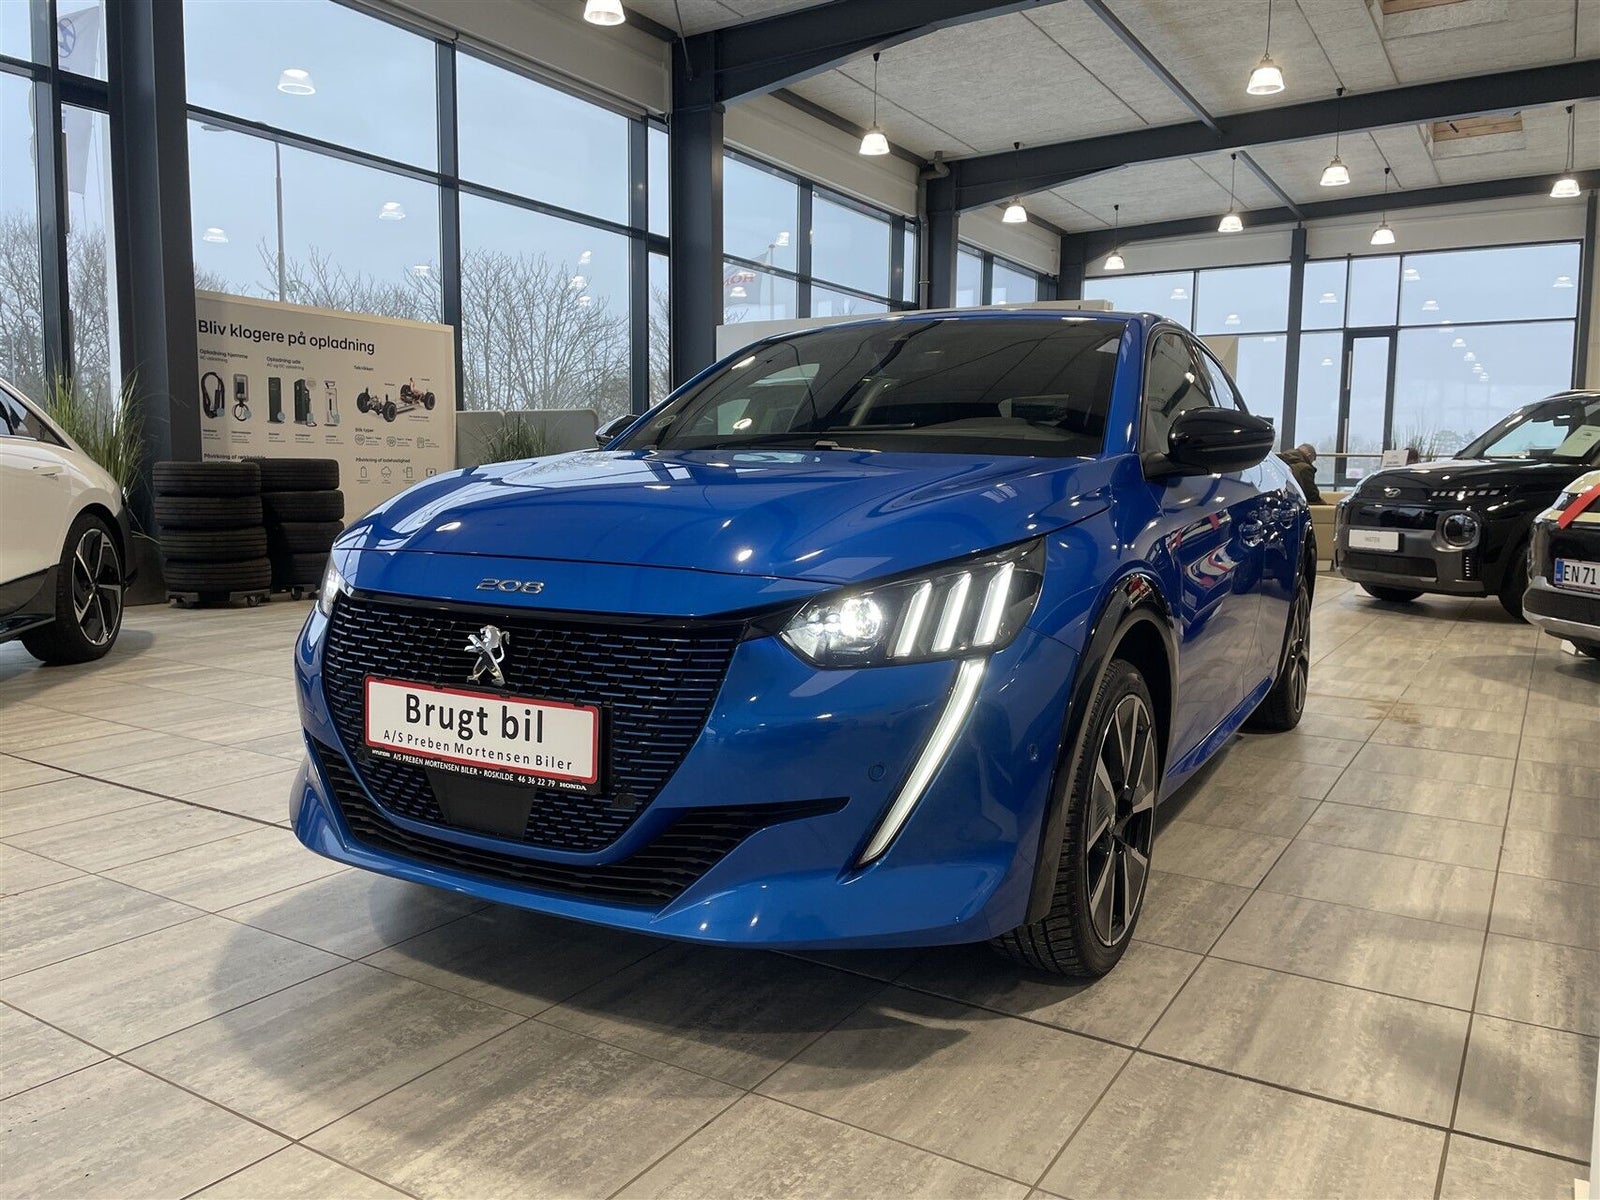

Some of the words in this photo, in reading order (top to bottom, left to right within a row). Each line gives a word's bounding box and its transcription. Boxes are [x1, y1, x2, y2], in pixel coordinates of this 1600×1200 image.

[198, 320, 226, 336] Bliv
[230, 323, 284, 343] klogere
[288, 332, 306, 346] på
[309, 334, 375, 355] opladning
[475, 577, 546, 594] 208
[1563, 564, 1580, 583] EN
[1583, 566, 1597, 585] 71
[406, 693, 488, 741] Brugt
[501, 705, 543, 743] bil
[383, 729, 403, 743] A/S
[407, 734, 449, 752] Preben
[454, 742, 530, 765] Mortensen
[535, 753, 573, 771] Biler
[392, 753, 402, 761] A/S
[402, 755, 424, 765] PREBEN
[424, 759, 460, 772] MORTENSEN
[460, 765, 478, 776] BILER
[483, 769, 514, 782] ROSKILDE
[517, 775, 526, 783] 46
[527, 777, 536, 785] 36
[537, 778, 546, 787] 22
[547, 779, 556, 788] 79
[559, 782, 587, 791] HONDA
